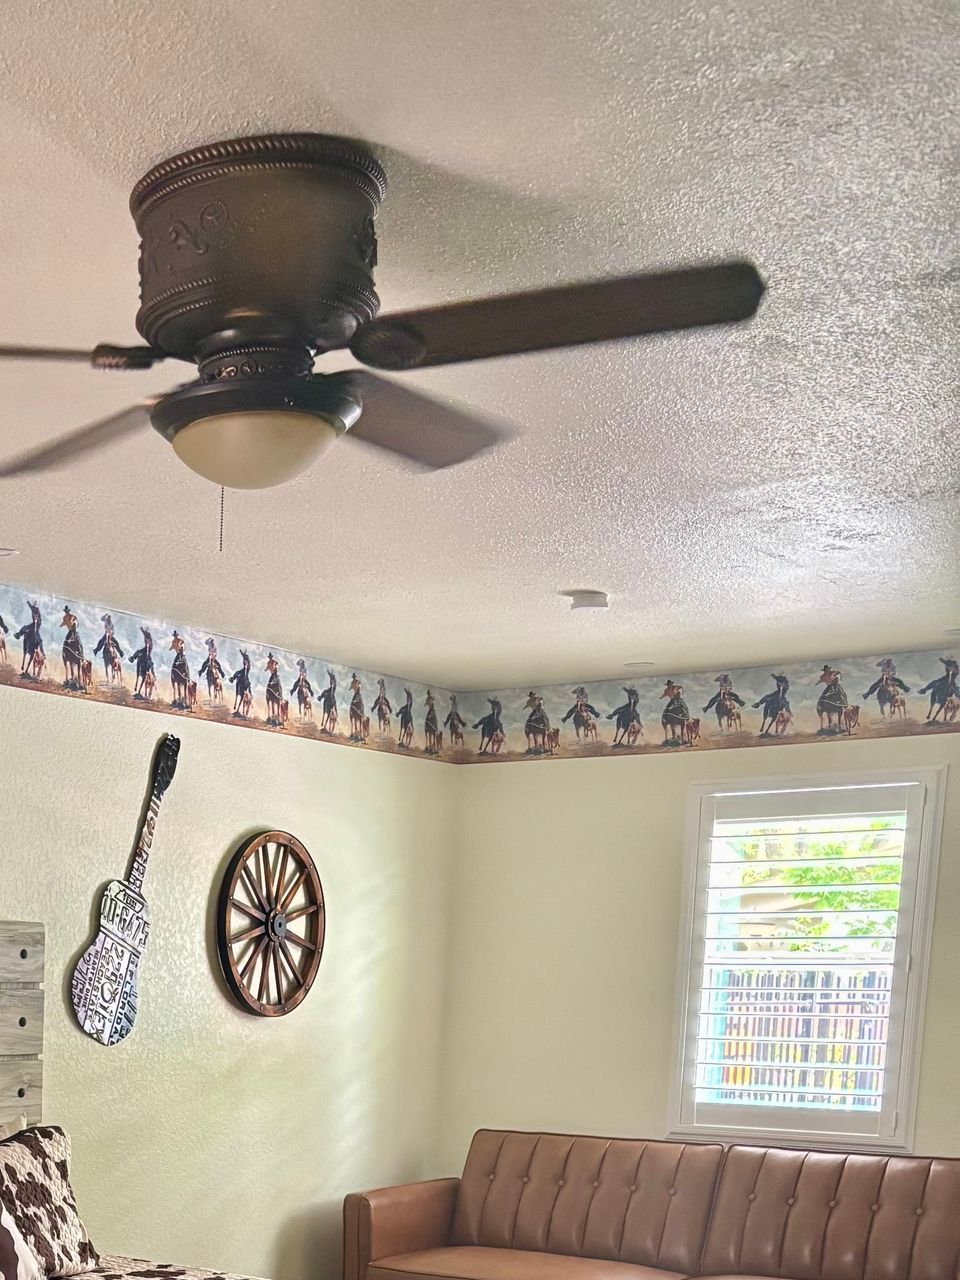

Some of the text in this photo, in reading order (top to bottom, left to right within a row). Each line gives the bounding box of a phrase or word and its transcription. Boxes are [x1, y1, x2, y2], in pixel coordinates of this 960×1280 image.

[90, 949, 101, 979] HEART
[95, 946, 110, 985] PEACH
[81, 987, 92, 1009] DIXIE
[113, 969, 135, 1035] FLORIDA
